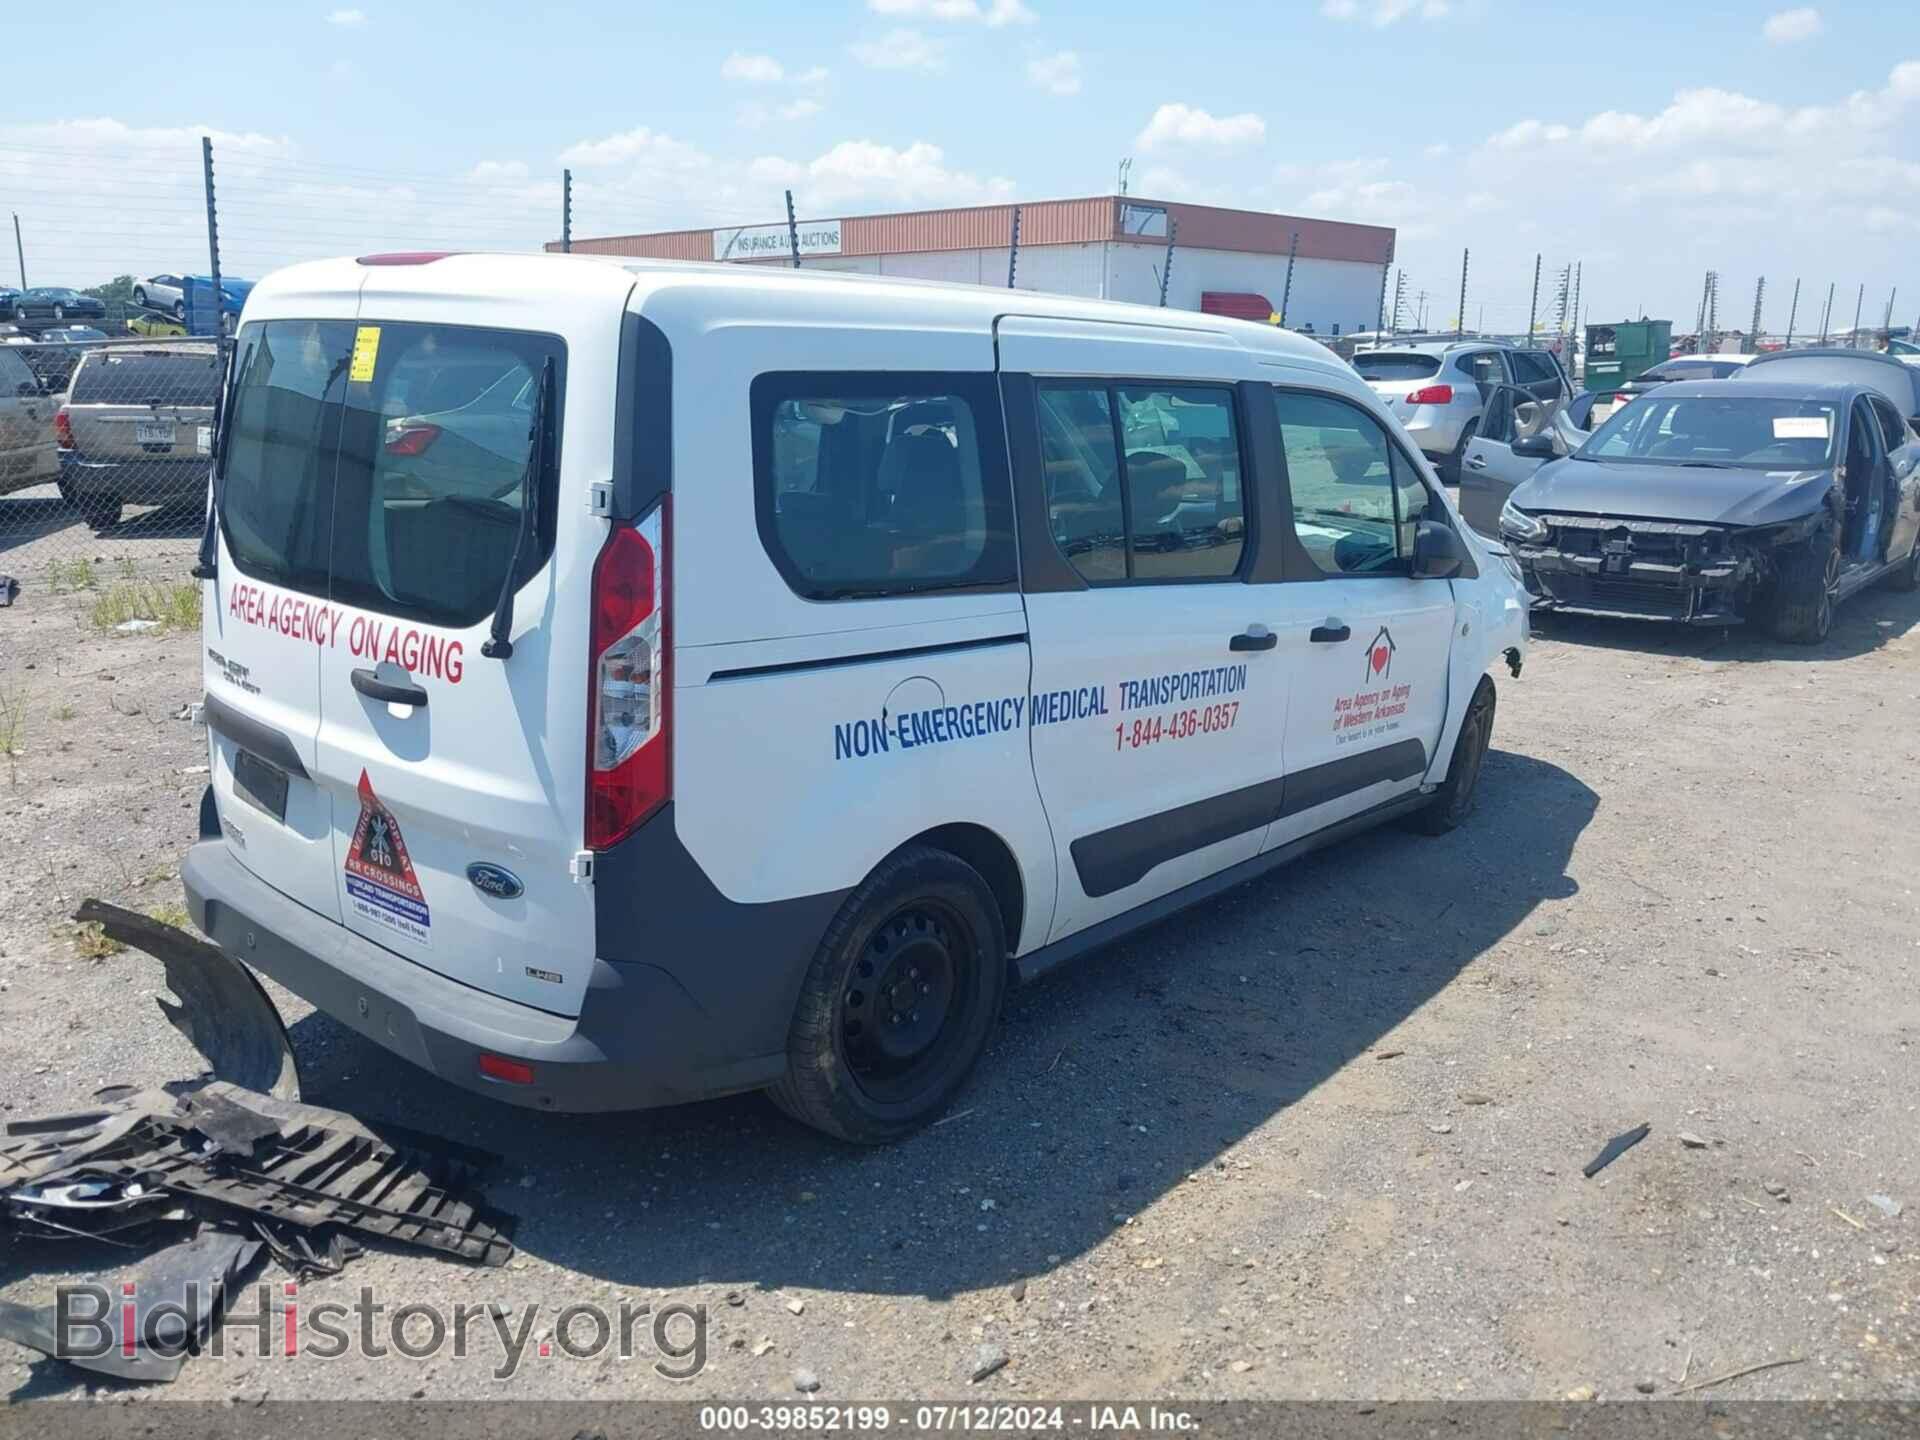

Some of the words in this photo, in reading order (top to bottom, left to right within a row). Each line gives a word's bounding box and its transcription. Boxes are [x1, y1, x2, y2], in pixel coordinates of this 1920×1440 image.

[737, 234, 777, 251] INSURANCE
[801, 231, 839, 247] AUCTIONS
[230, 582, 265, 628] AREA
[268, 592, 343, 648] AGENCY
[349, 616, 382, 662] ON
[384, 626, 464, 684] AGING
[834, 695, 1026, 761] NON-EMERGENCY
[1031, 685, 1109, 726] MEDICAL
[1118, 664, 1248, 711] TRANSPORTATION
[1334, 697, 1353, 713] Area
[1354, 692, 1380, 709] Agency
[1391, 684, 1411, 702] Aging
[1114, 701, 1241, 752] 1-844-436-0357
[1343, 710, 1373, 729] Western
[1374, 702, 1406, 720] Arkansas
[364, 865, 421, 898] CROSSINGS
